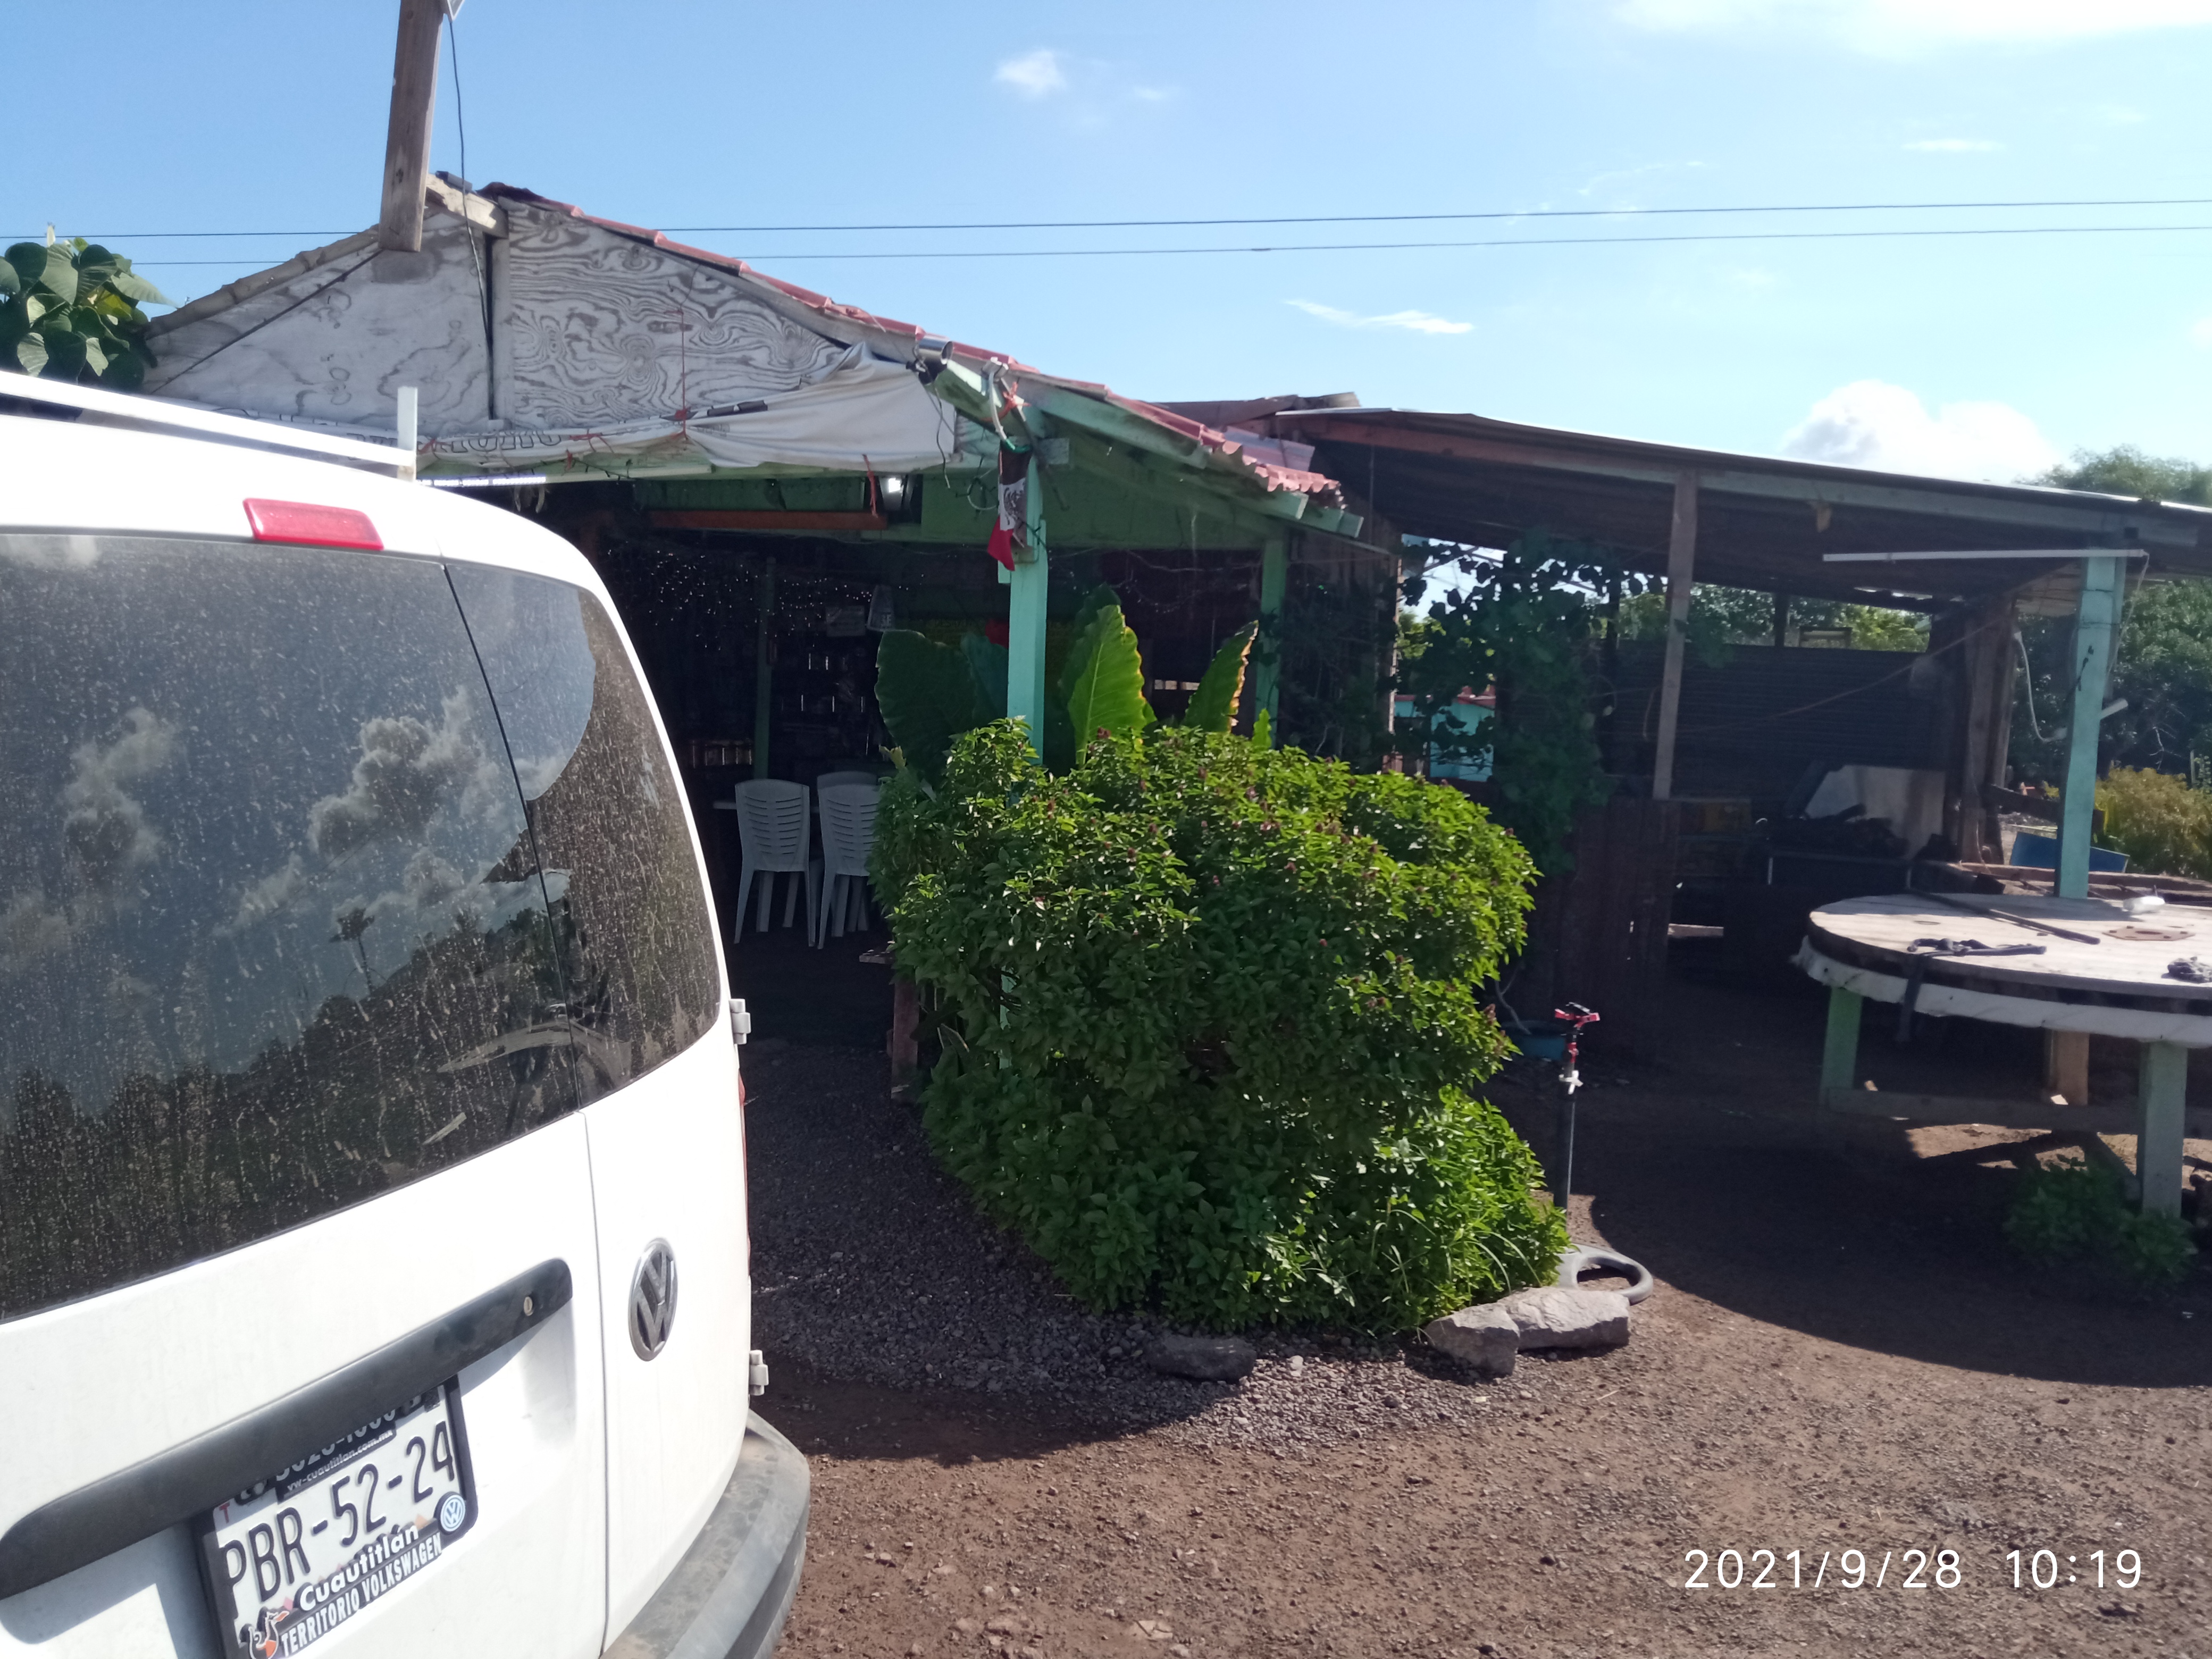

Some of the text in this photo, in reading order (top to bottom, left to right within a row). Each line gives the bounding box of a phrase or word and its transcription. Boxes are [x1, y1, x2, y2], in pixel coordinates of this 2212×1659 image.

[223, 1421, 455, 1602] PBR-52-24
[300, 1525, 419, 1611] Cuautitlán
[281, 1532, 442, 1657] TERRITORIO VOLKSWAGEN
